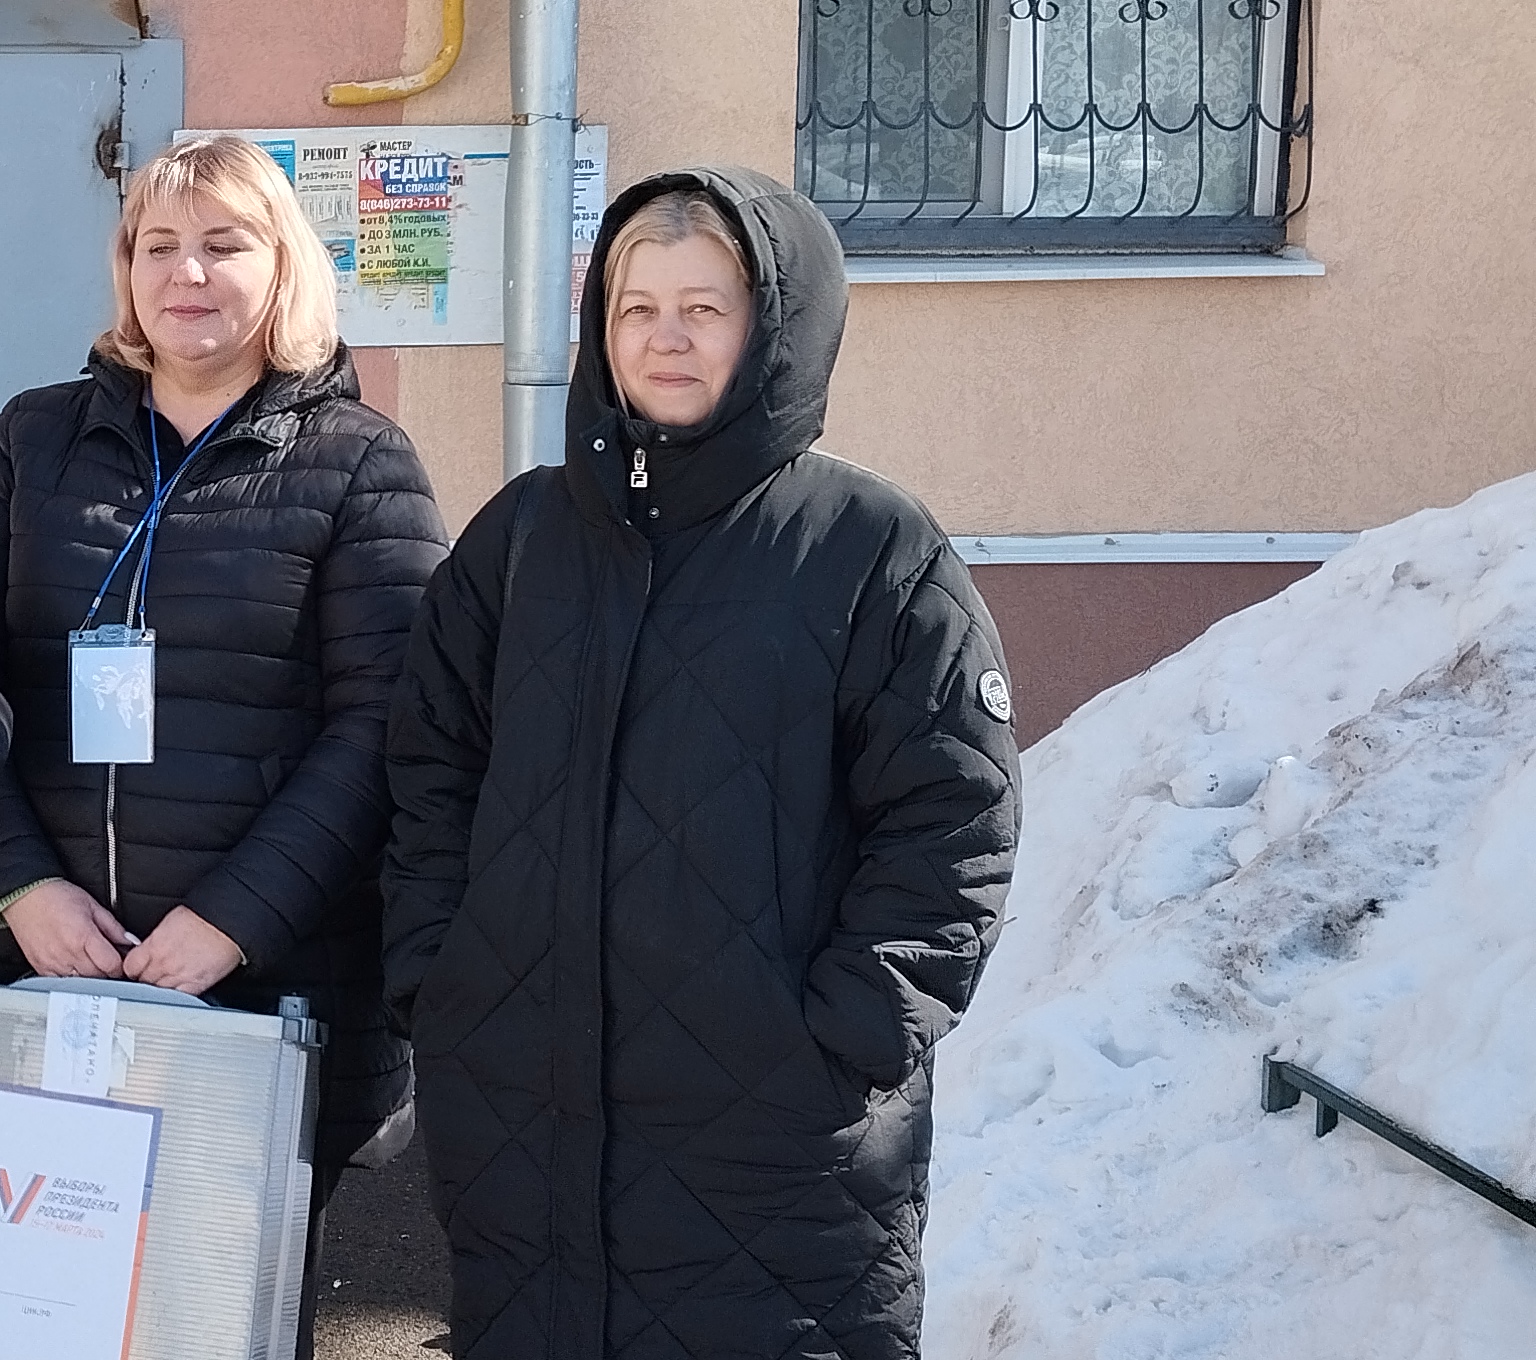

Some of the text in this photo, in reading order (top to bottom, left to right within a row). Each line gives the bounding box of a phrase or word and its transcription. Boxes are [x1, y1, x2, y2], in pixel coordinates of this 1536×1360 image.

[379, 141, 412, 151] МАСТЕР
[303, 147, 348, 161] РЕМОНТ
[360, 157, 447, 182] КРЕДИТ
[385, 182, 447, 194] БЕЗ СПРАВОК
[367, 229, 383, 241] ДО
[420, 227, 444, 238] РУБ.
[367, 243, 415, 255] ЗА 1 ЧАС
[366, 259, 374, 269] С
[375, 256, 411, 269] ЛЮБОЙ
[52, 1176, 106, 1196] ВЫБОРЫ
[43, 1190, 120, 1214] ПРЕЗИДЕНТА
[36, 1204, 86, 1222] РОССИИ
